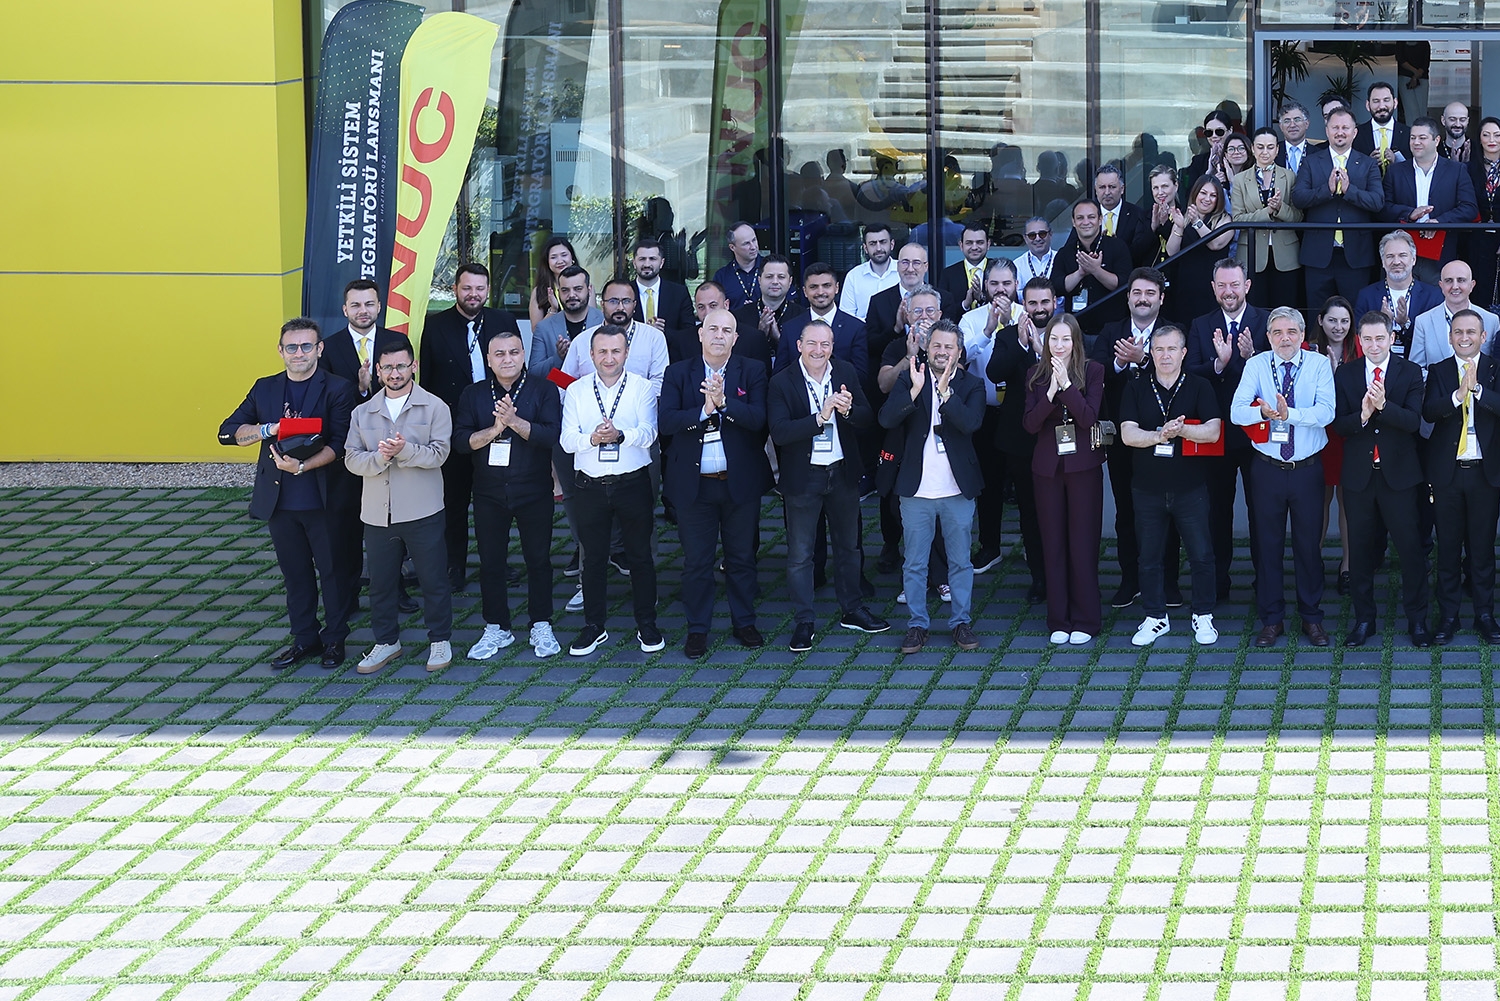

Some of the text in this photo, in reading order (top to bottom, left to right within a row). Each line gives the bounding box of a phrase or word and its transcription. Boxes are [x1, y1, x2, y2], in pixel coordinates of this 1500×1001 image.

[337, 101, 361, 264] YETKİLİ SİSTEM
[361, 49, 384, 281] EGRATÖRÜ LANSMANI
[385, 87, 455, 335] NUC
